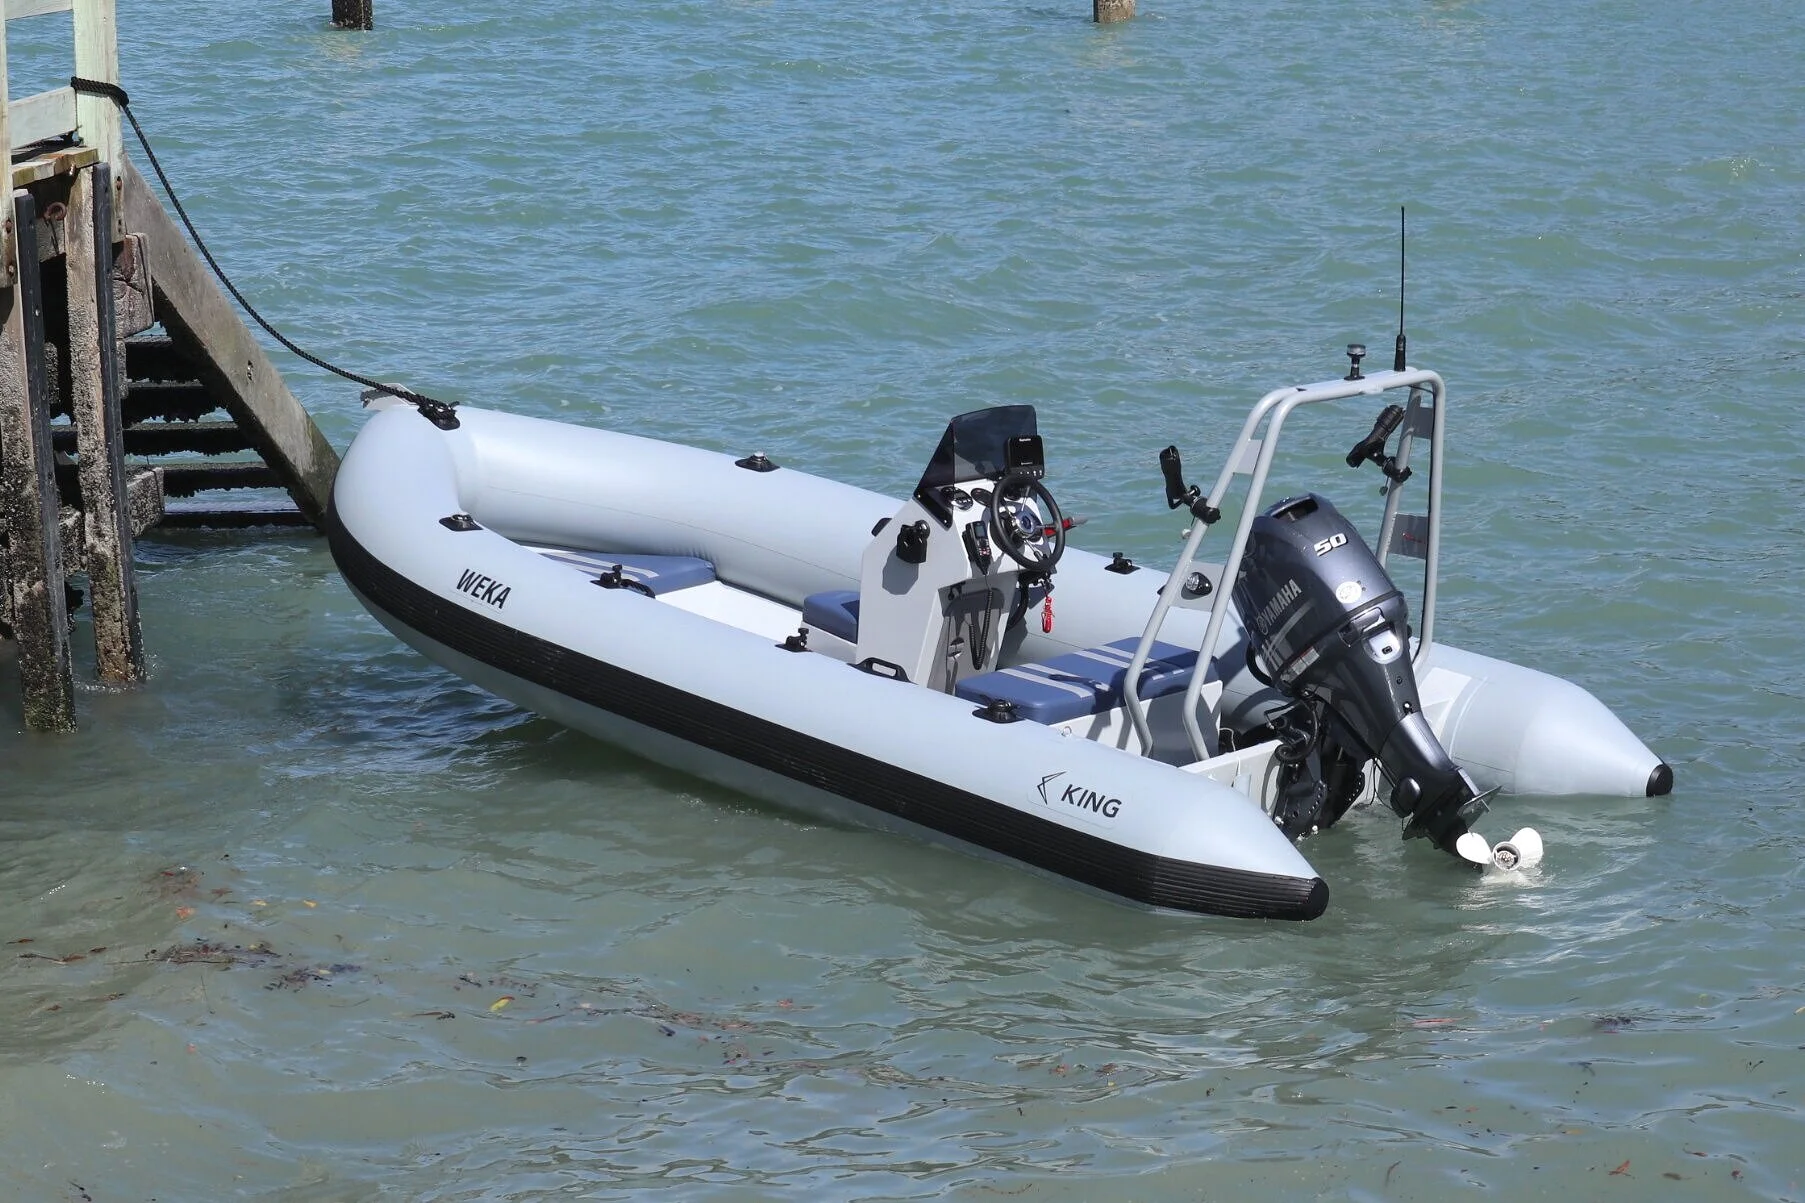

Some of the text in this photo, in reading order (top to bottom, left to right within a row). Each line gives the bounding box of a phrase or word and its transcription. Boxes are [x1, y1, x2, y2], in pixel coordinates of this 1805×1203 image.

[1314, 533, 1347, 556] 50
[456, 568, 512, 609] WEKA
[1261, 579, 1302, 627] YAMAHA
[1061, 784, 1122, 818] KING
